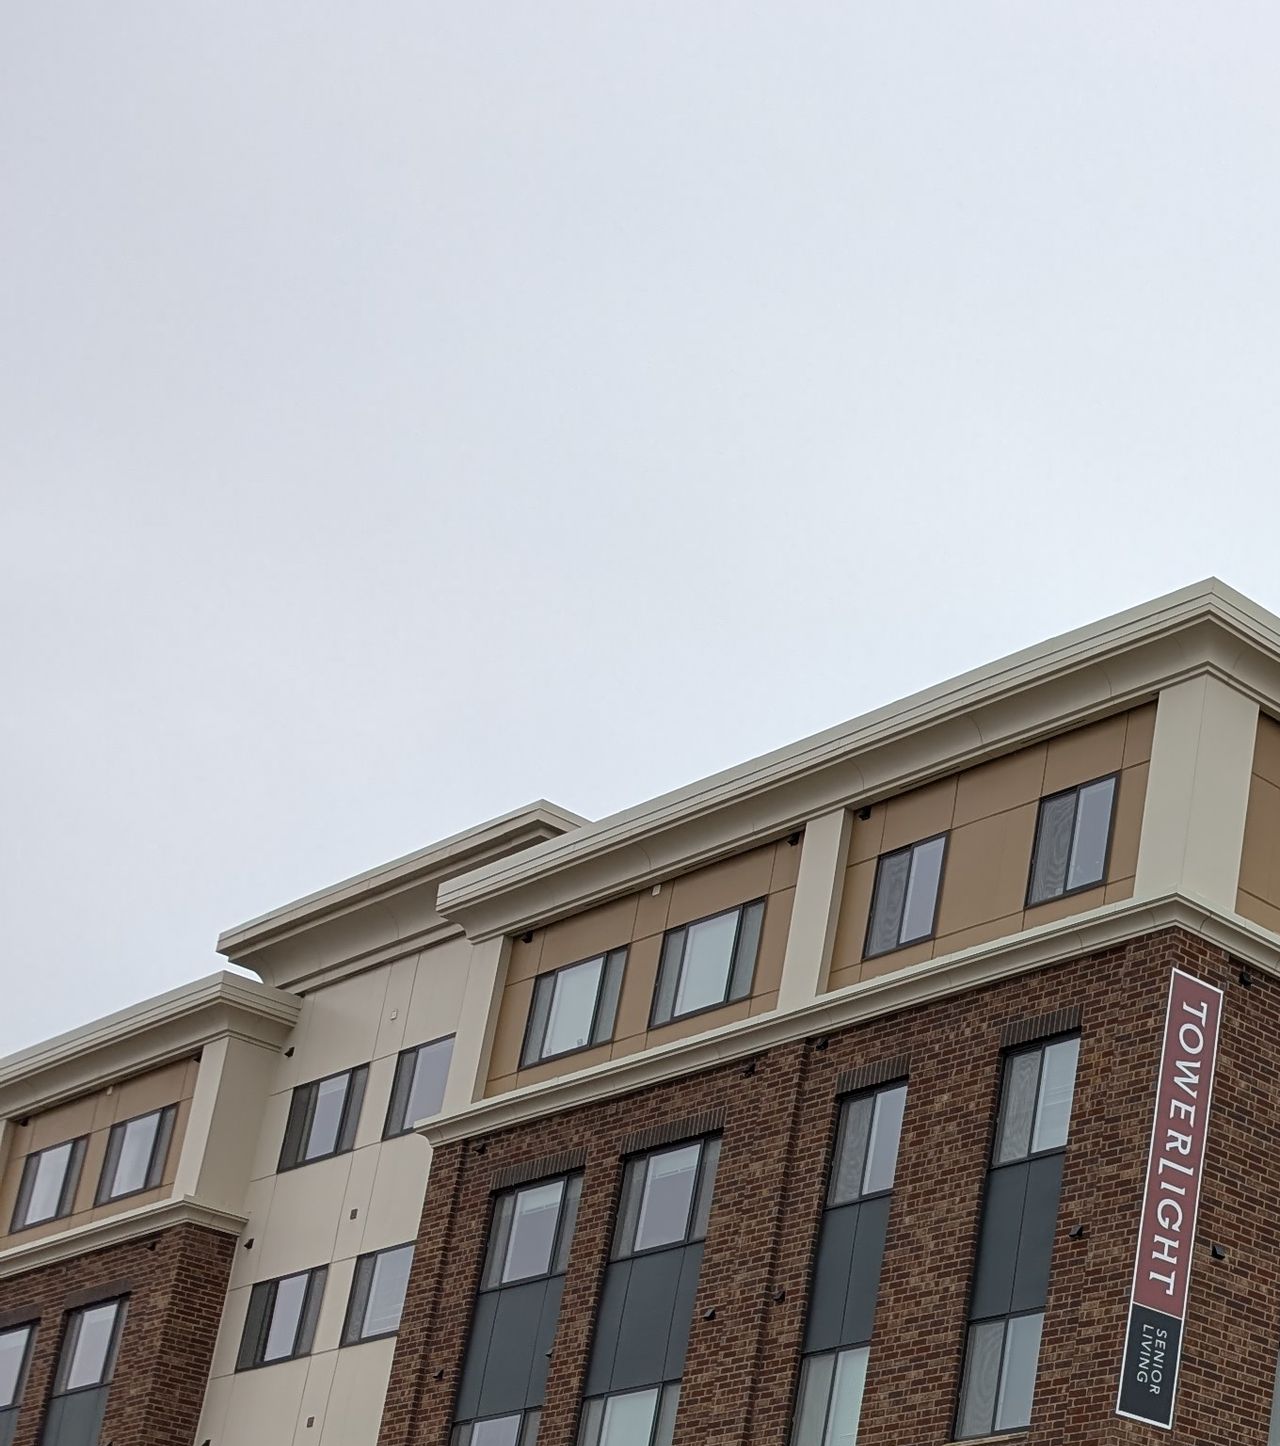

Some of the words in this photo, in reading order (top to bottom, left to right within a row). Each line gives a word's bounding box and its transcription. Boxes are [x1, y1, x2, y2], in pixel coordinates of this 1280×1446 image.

[1149, 1000, 1208, 1296] TOWERLIGHT
[1136, 1323, 1154, 1384] LIVING
[1148, 1328, 1168, 1396] SENIOR
